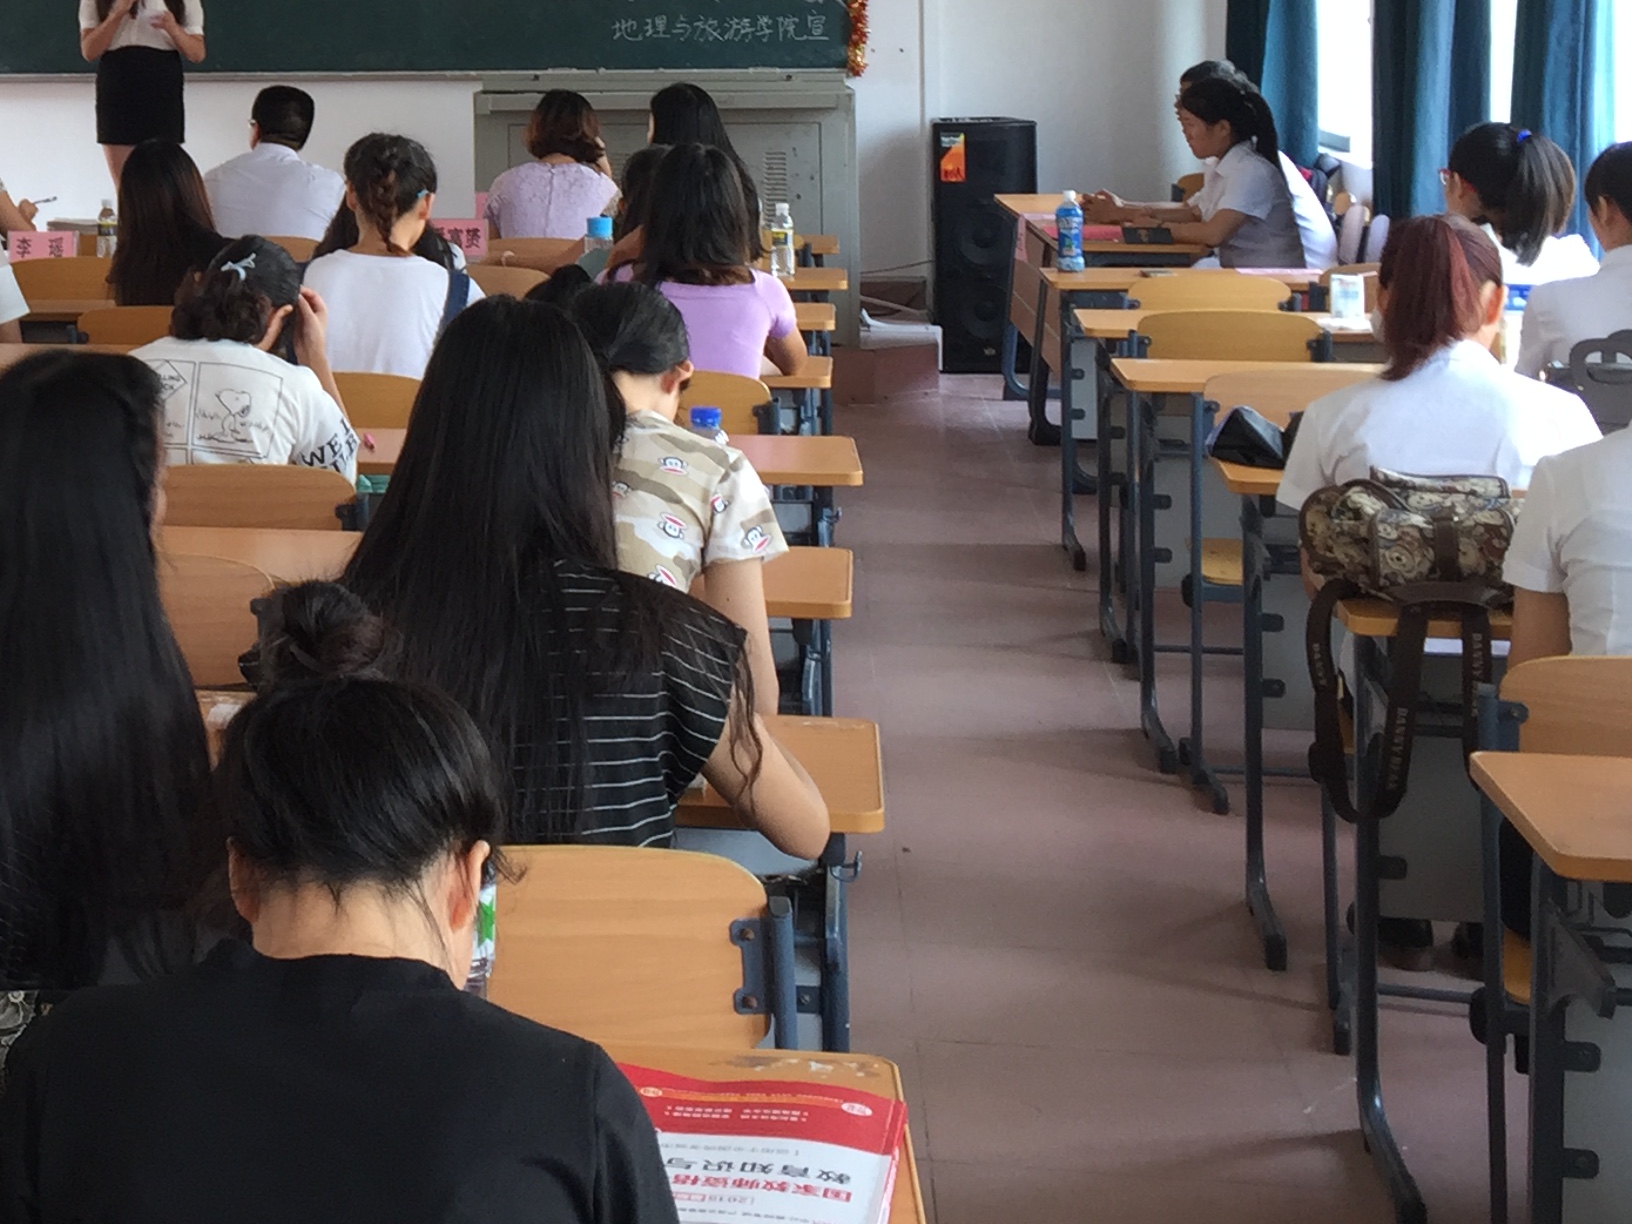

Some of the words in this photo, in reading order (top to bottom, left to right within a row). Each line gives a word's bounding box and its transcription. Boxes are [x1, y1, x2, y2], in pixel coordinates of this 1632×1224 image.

[611, 14, 831, 43] 地理与旅游学院宣
[299, 433, 343, 467] WE
